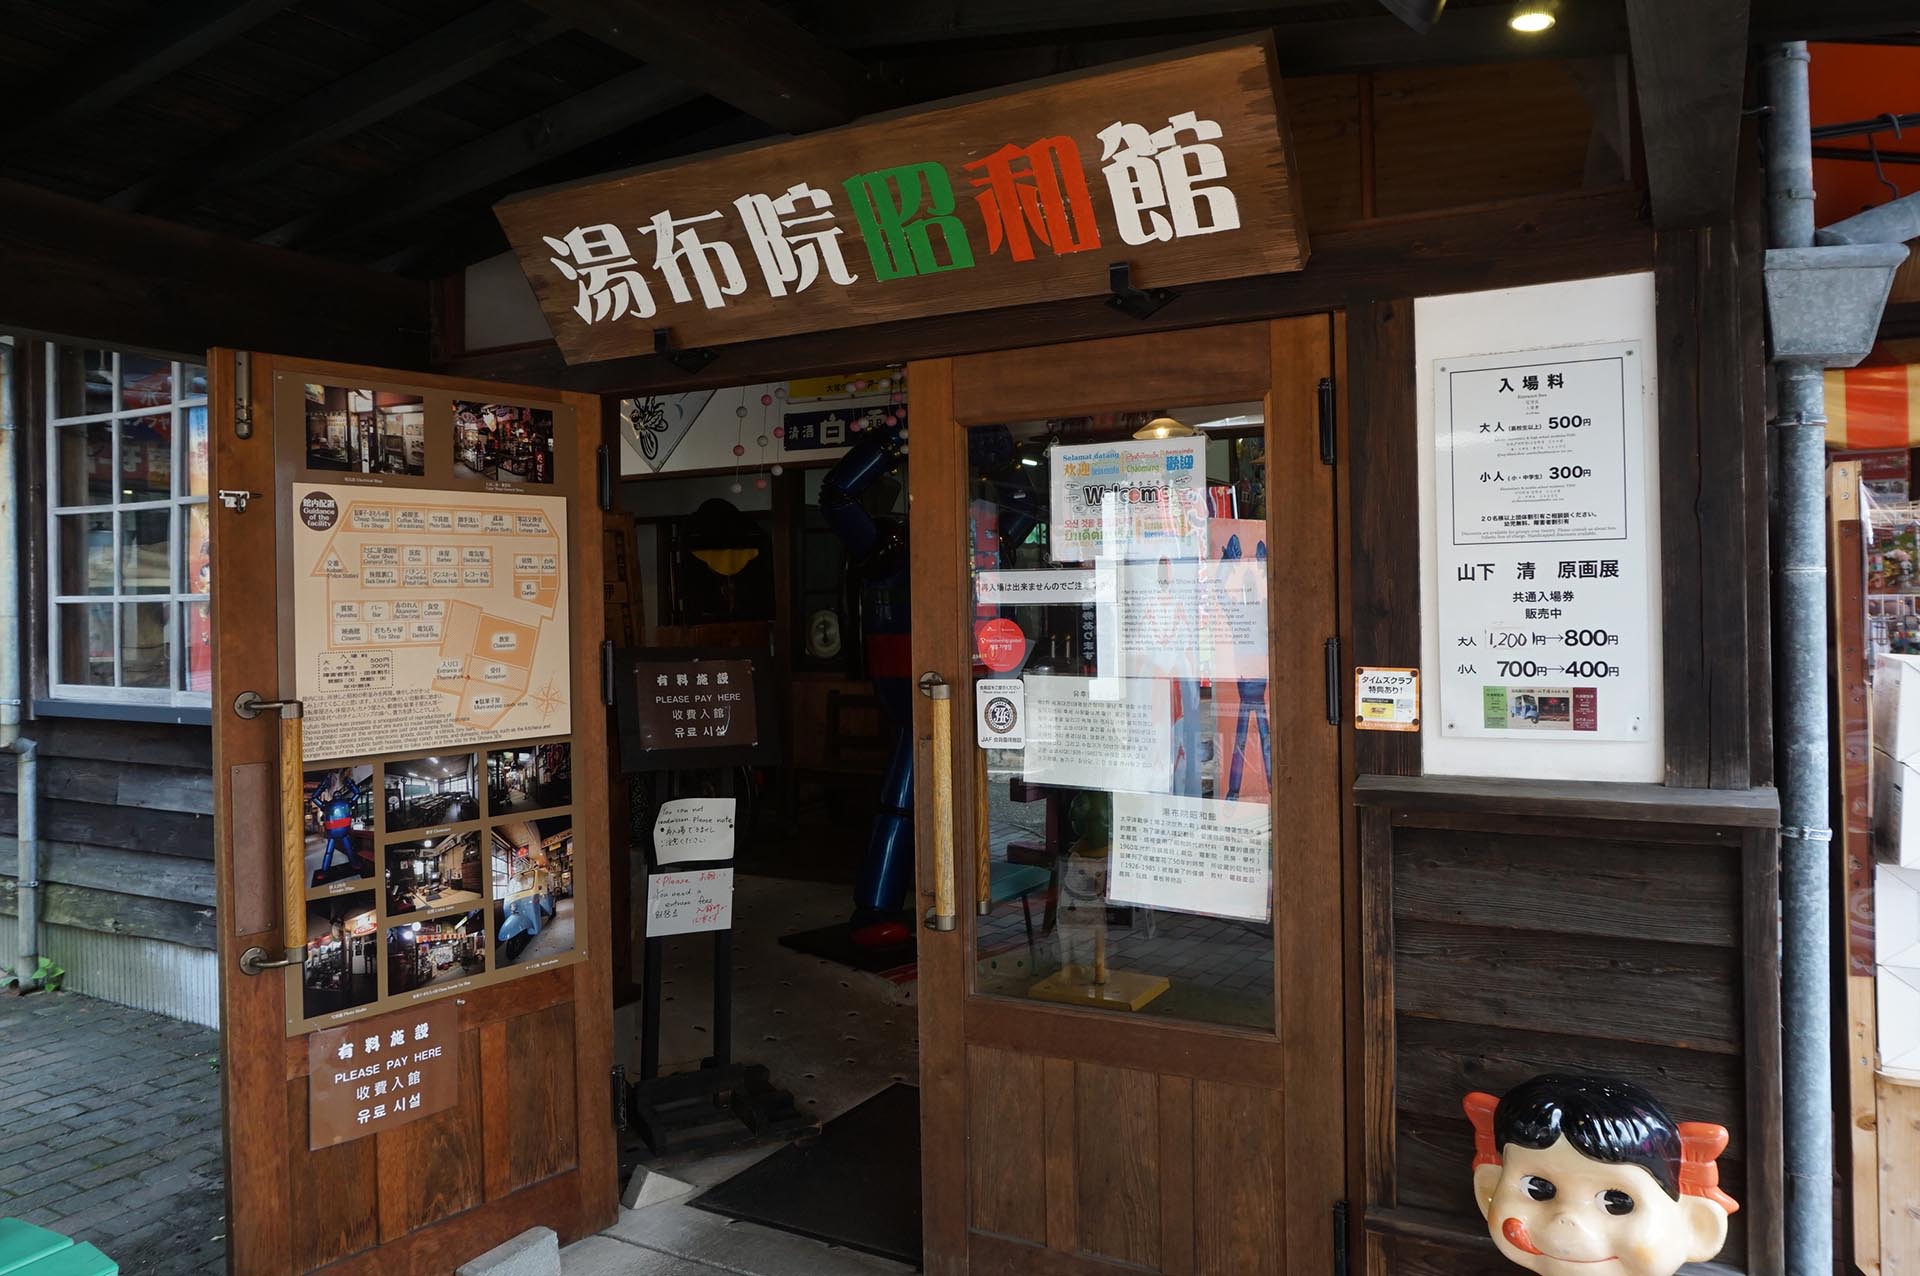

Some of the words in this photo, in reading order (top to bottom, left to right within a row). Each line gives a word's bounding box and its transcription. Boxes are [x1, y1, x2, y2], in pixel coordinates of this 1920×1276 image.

[542, 110, 1240, 326] 湯布院昭和館
[1498, 373, 1564, 393] 入場料
[1479, 421, 1505, 434] 大人
[1548, 415, 1592, 430] 500円
[1063, 454, 1092, 462] Selamat
[1064, 462, 1090, 477] 欢迎
[1479, 471, 1505, 483] 小人
[1548, 465, 1592, 480] 300円
[303, 507, 335, 515] Guidance
[307, 520, 332, 528] facility
[1457, 563, 1495, 582] 山下
[1516, 561, 1537, 580] 清
[1557, 559, 1620, 579] 原画展
[1512, 591, 1575, 603] 共通入場券
[1525, 608, 1562, 620] 販売中
[1457, 636, 1477, 647] 大人
[1564, 629, 1619, 647] 800円
[1457, 664, 1477, 675] 小人
[1496, 660, 1548, 678] 700円
[1565, 660, 1620, 678] 400円
[657, 672, 729, 686] 有料施設
[1361, 676, 1413, 685] タイムズクラブ
[655, 695, 690, 704] PLEASE
[694, 694, 713, 702] PAY
[717, 693, 741, 701] HERE
[674, 727, 697, 738] 유료
[703, 725, 726, 737] 시설
[337, 1022, 430, 1060] 有料施設
[334, 1063, 381, 1084] PLEASE
[386, 1055, 409, 1071] PAY
[414, 1046, 442, 1063] HERE
[357, 1104, 387, 1125] 유료
[393, 1092, 421, 1113] 시설
